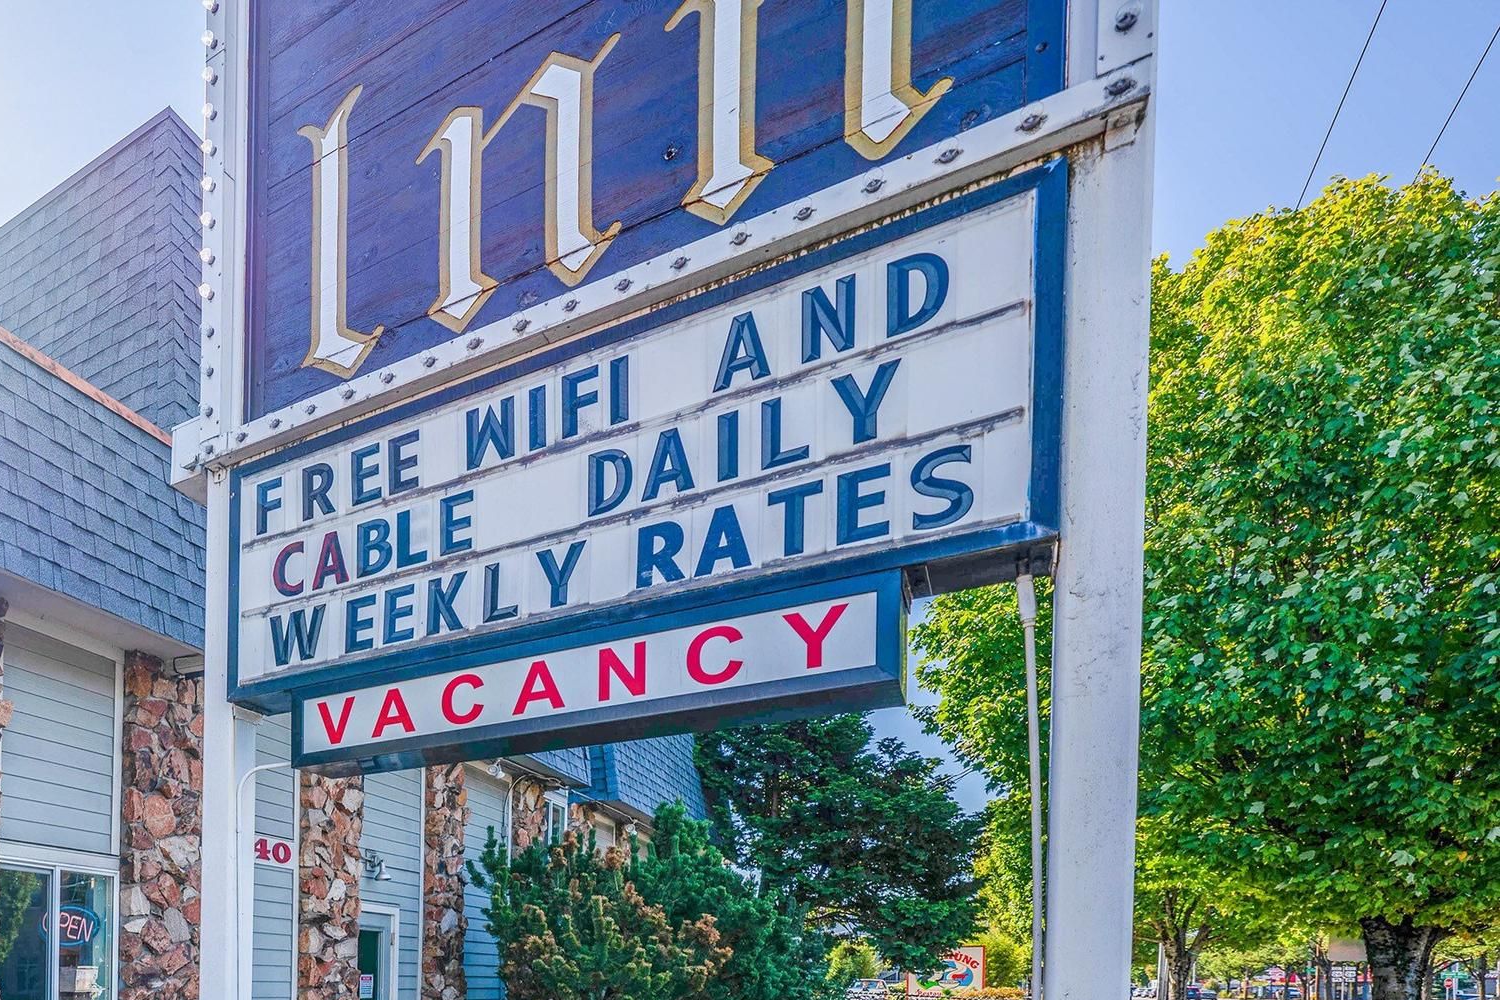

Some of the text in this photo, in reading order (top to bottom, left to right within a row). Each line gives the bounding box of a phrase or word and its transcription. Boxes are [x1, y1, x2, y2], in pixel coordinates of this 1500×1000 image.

[297, 0, 954, 379] Inn
[256, 251, 948, 535] FREE WIFI AND
[273, 358, 901, 597] CABLE DAILY
[270, 444, 974, 666] WEEKLY RATES
[316, 602, 849, 746] VACANCY
[254, 838, 292, 864] 40
